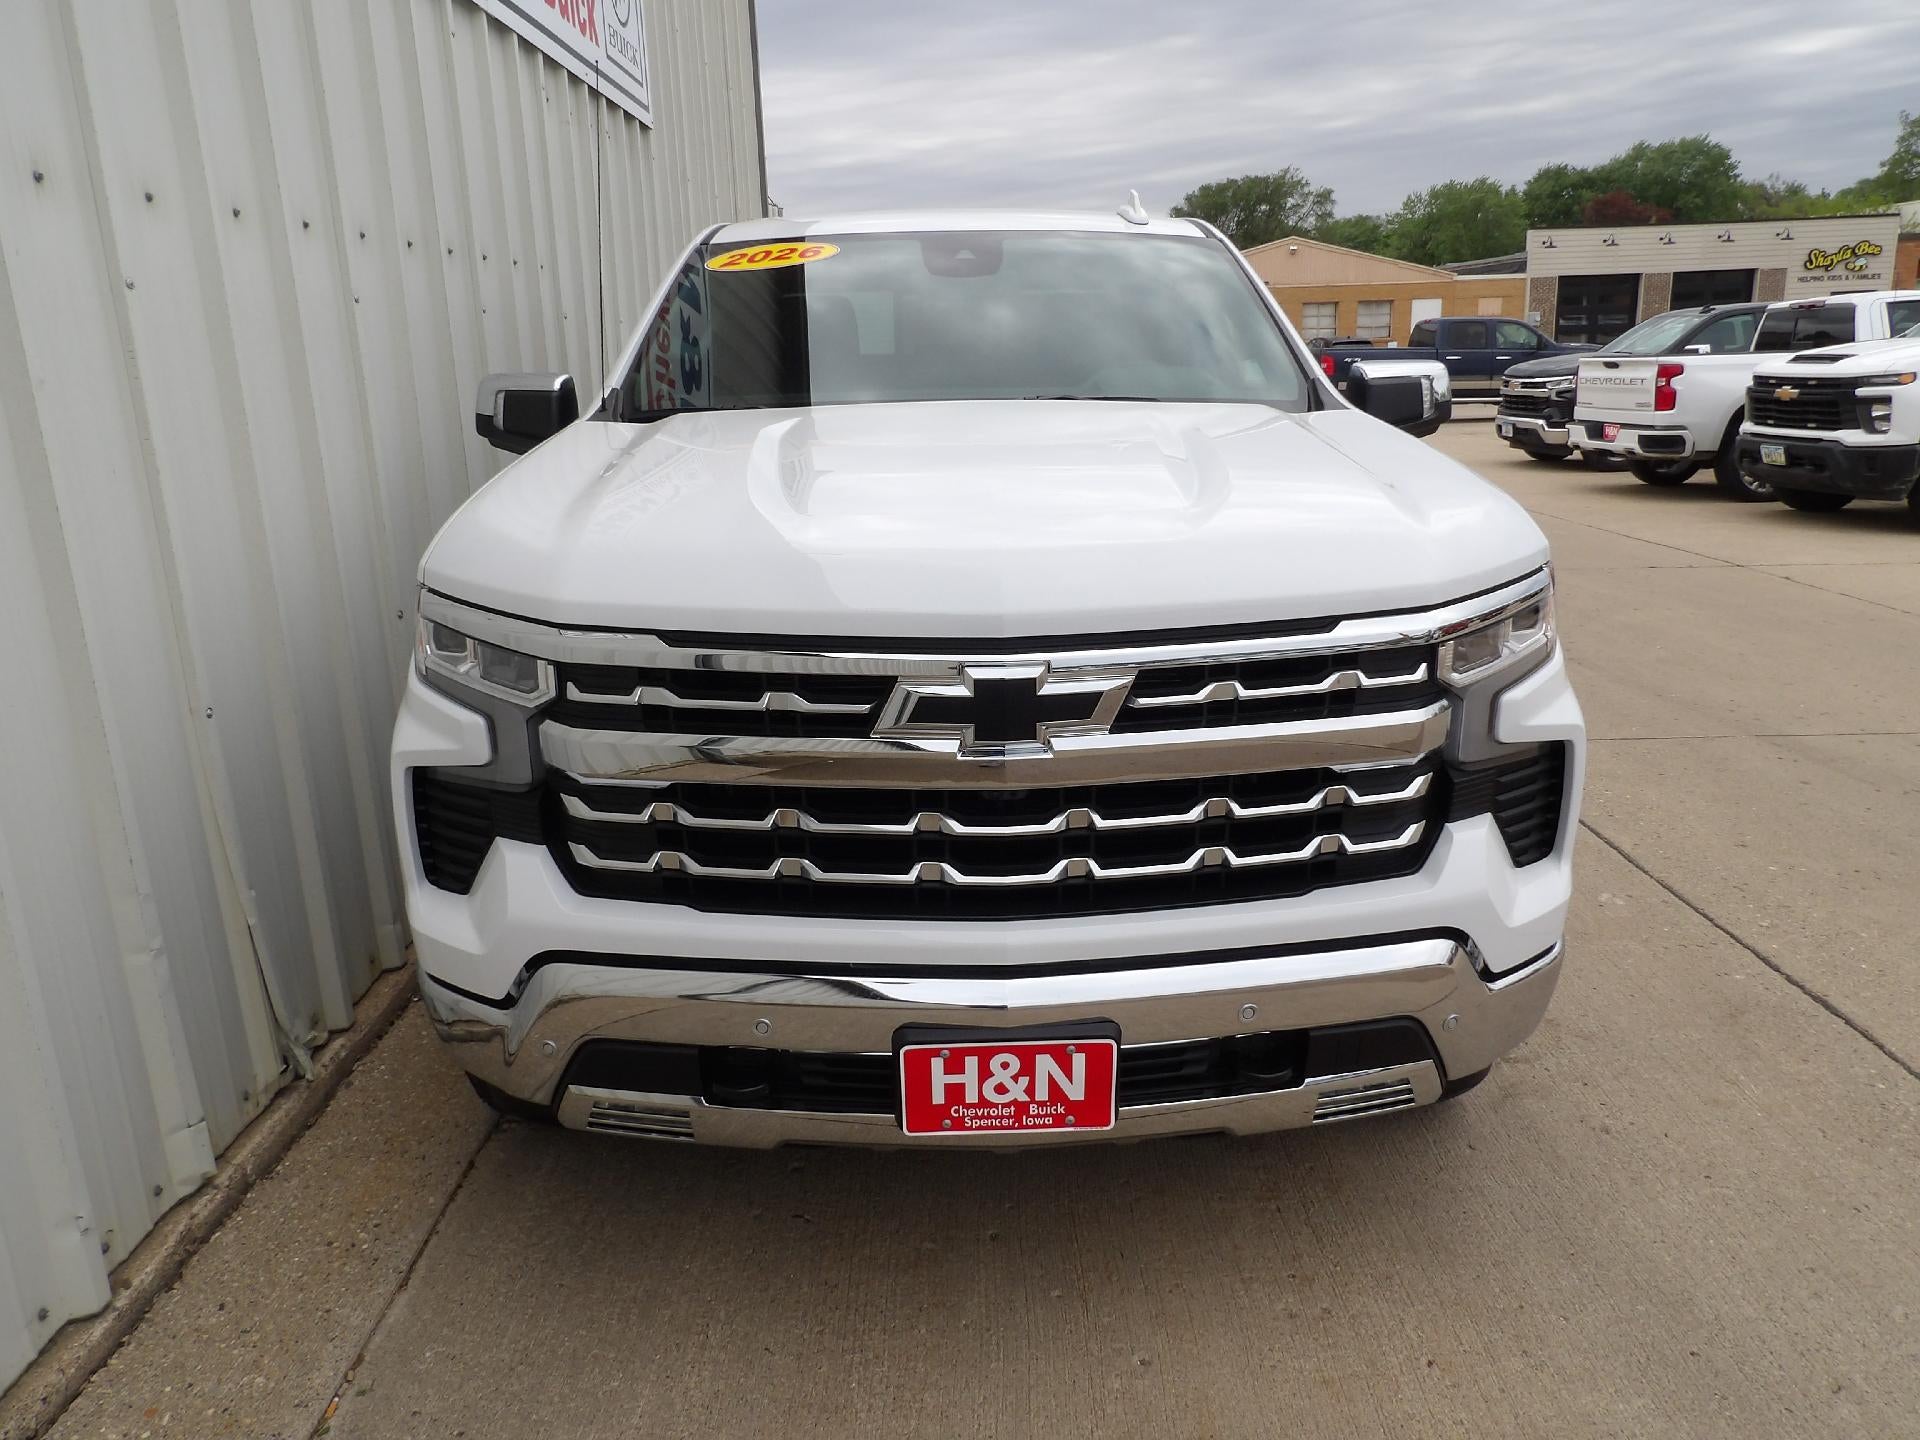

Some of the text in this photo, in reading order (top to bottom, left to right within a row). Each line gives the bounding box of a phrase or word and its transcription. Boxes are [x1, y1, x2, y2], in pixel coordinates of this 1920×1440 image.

[607, 23, 640, 70] BUICK
[720, 245, 825, 269] 2026
[1805, 240, 1882, 271] Shayla Bee
[1797, 275, 1825, 283] HELPING
[1827, 274, 1843, 282] KIDS
[1852, 273, 1881, 281] FAMILIES
[1579, 377, 1648, 386] CHEVROLET
[931, 1052, 1086, 1104] H&N
[950, 1103, 1066, 1117] Chevrolet Buick
[964, 1115, 1053, 1128] Spencer, Iowa
